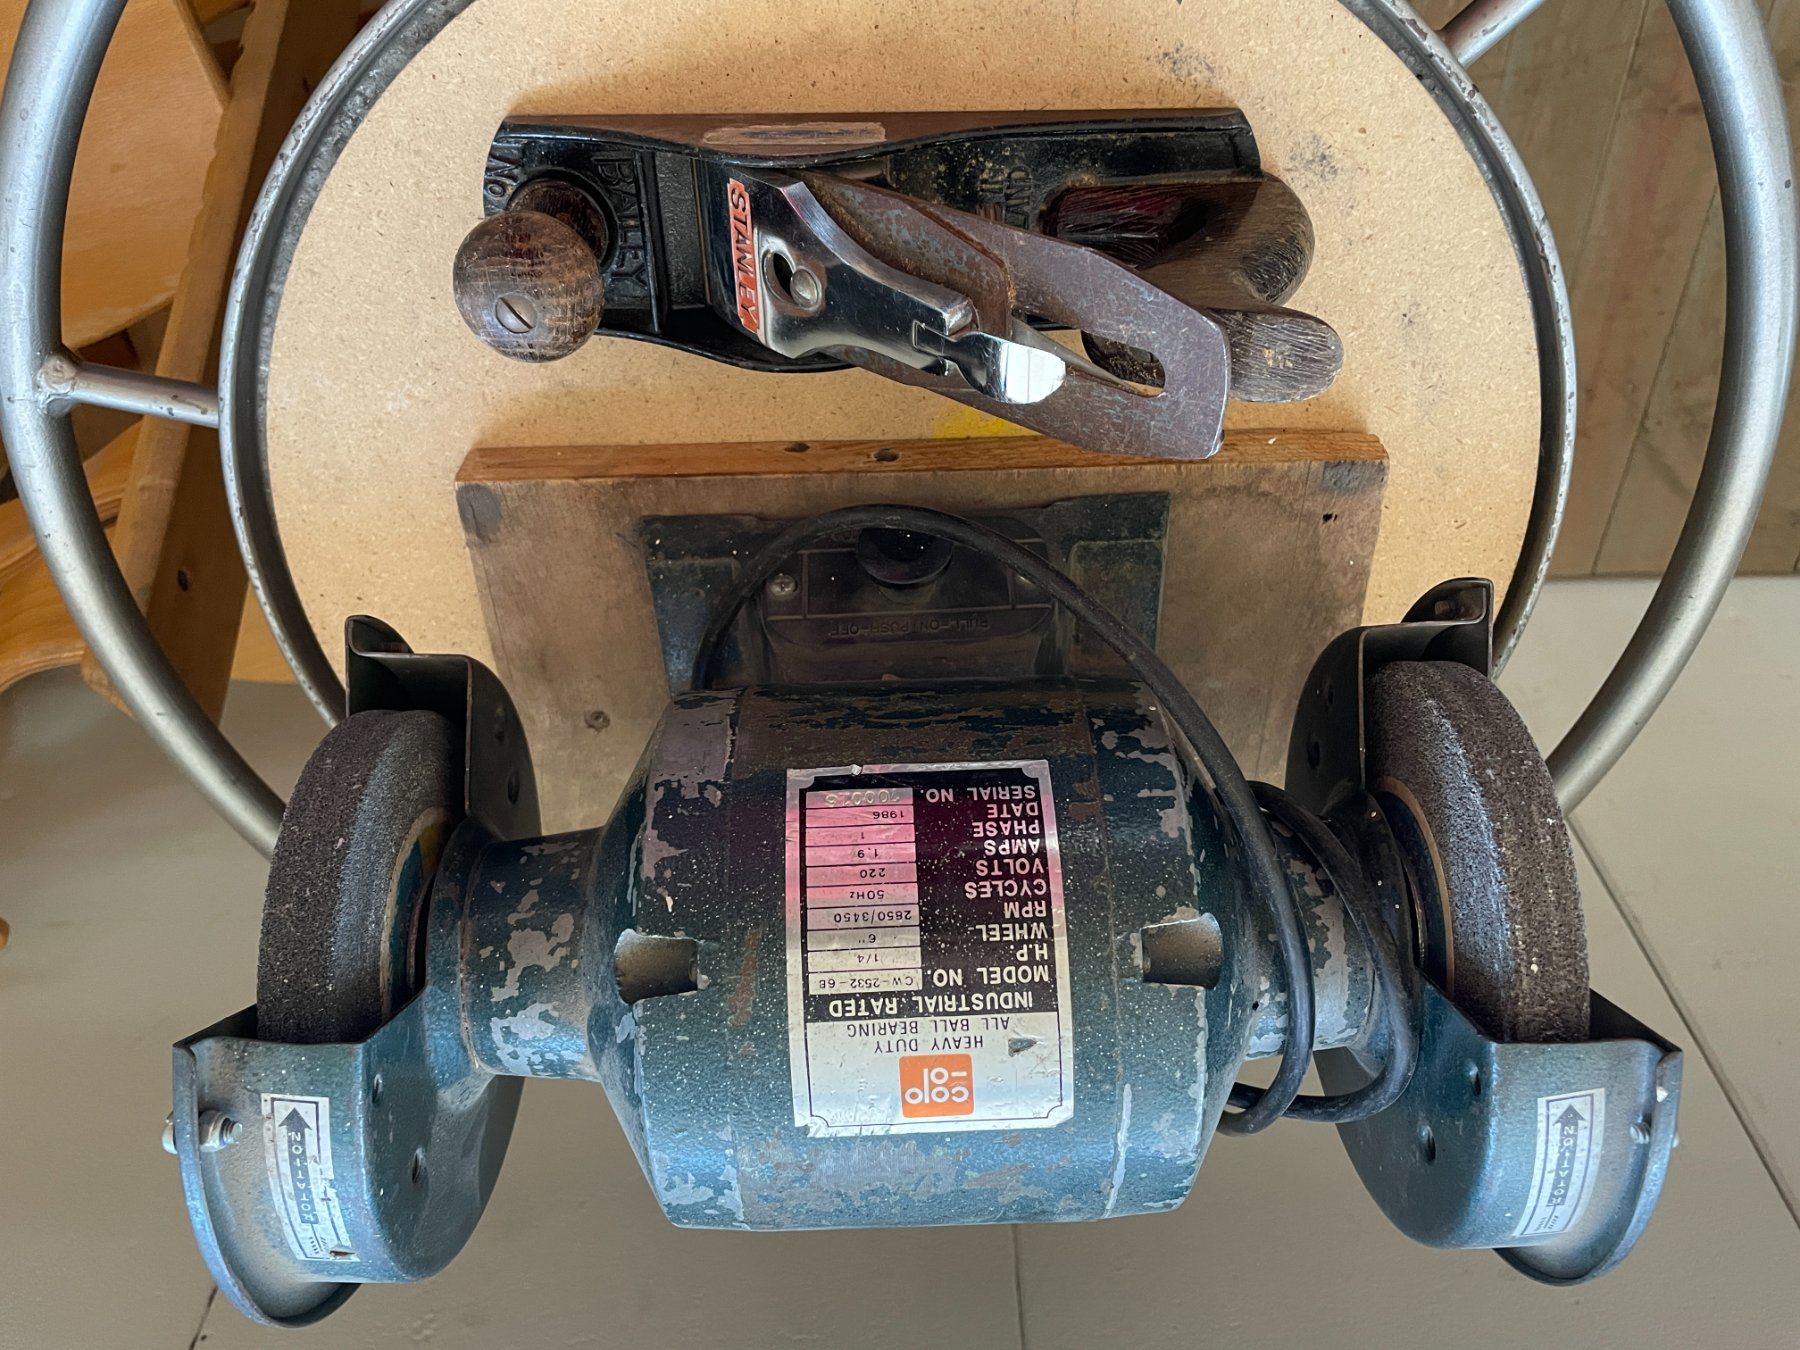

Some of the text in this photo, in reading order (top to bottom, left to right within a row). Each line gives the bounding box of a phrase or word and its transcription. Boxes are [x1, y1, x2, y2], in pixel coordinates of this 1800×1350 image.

[594, 156, 648, 290] BAILEY
[731, 189, 759, 329] STANLEY
[920, 788, 954, 802] NO.
[967, 785, 1036, 801] SERIAL
[872, 801, 1038, 820] DATE 1986
[971, 819, 1041, 836] PHASE
[857, 838, 1041, 858] AMPS 1.9
[859, 857, 1044, 878] VOLTS 220
[849, 878, 1047, 900] CYCLES 50Hz
[833, 901, 1046, 923] RPM 2850/3450
[976, 922, 1047, 941] WHEEL
[857, 942, 1049, 964] H.P. 1/4
[926, 968, 963, 989] NO.
[976, 964, 1049, 986] MODEL
[828, 991, 1033, 1017] INDUSTRIAL RATED
[846, 1016, 1010, 1038] ALL BALL BEARING
[874, 1035, 983, 1053] HEAVY DUTY
[1551, 1125, 1575, 1204] ROTATION
[291, 1131, 314, 1222] ROTATION
